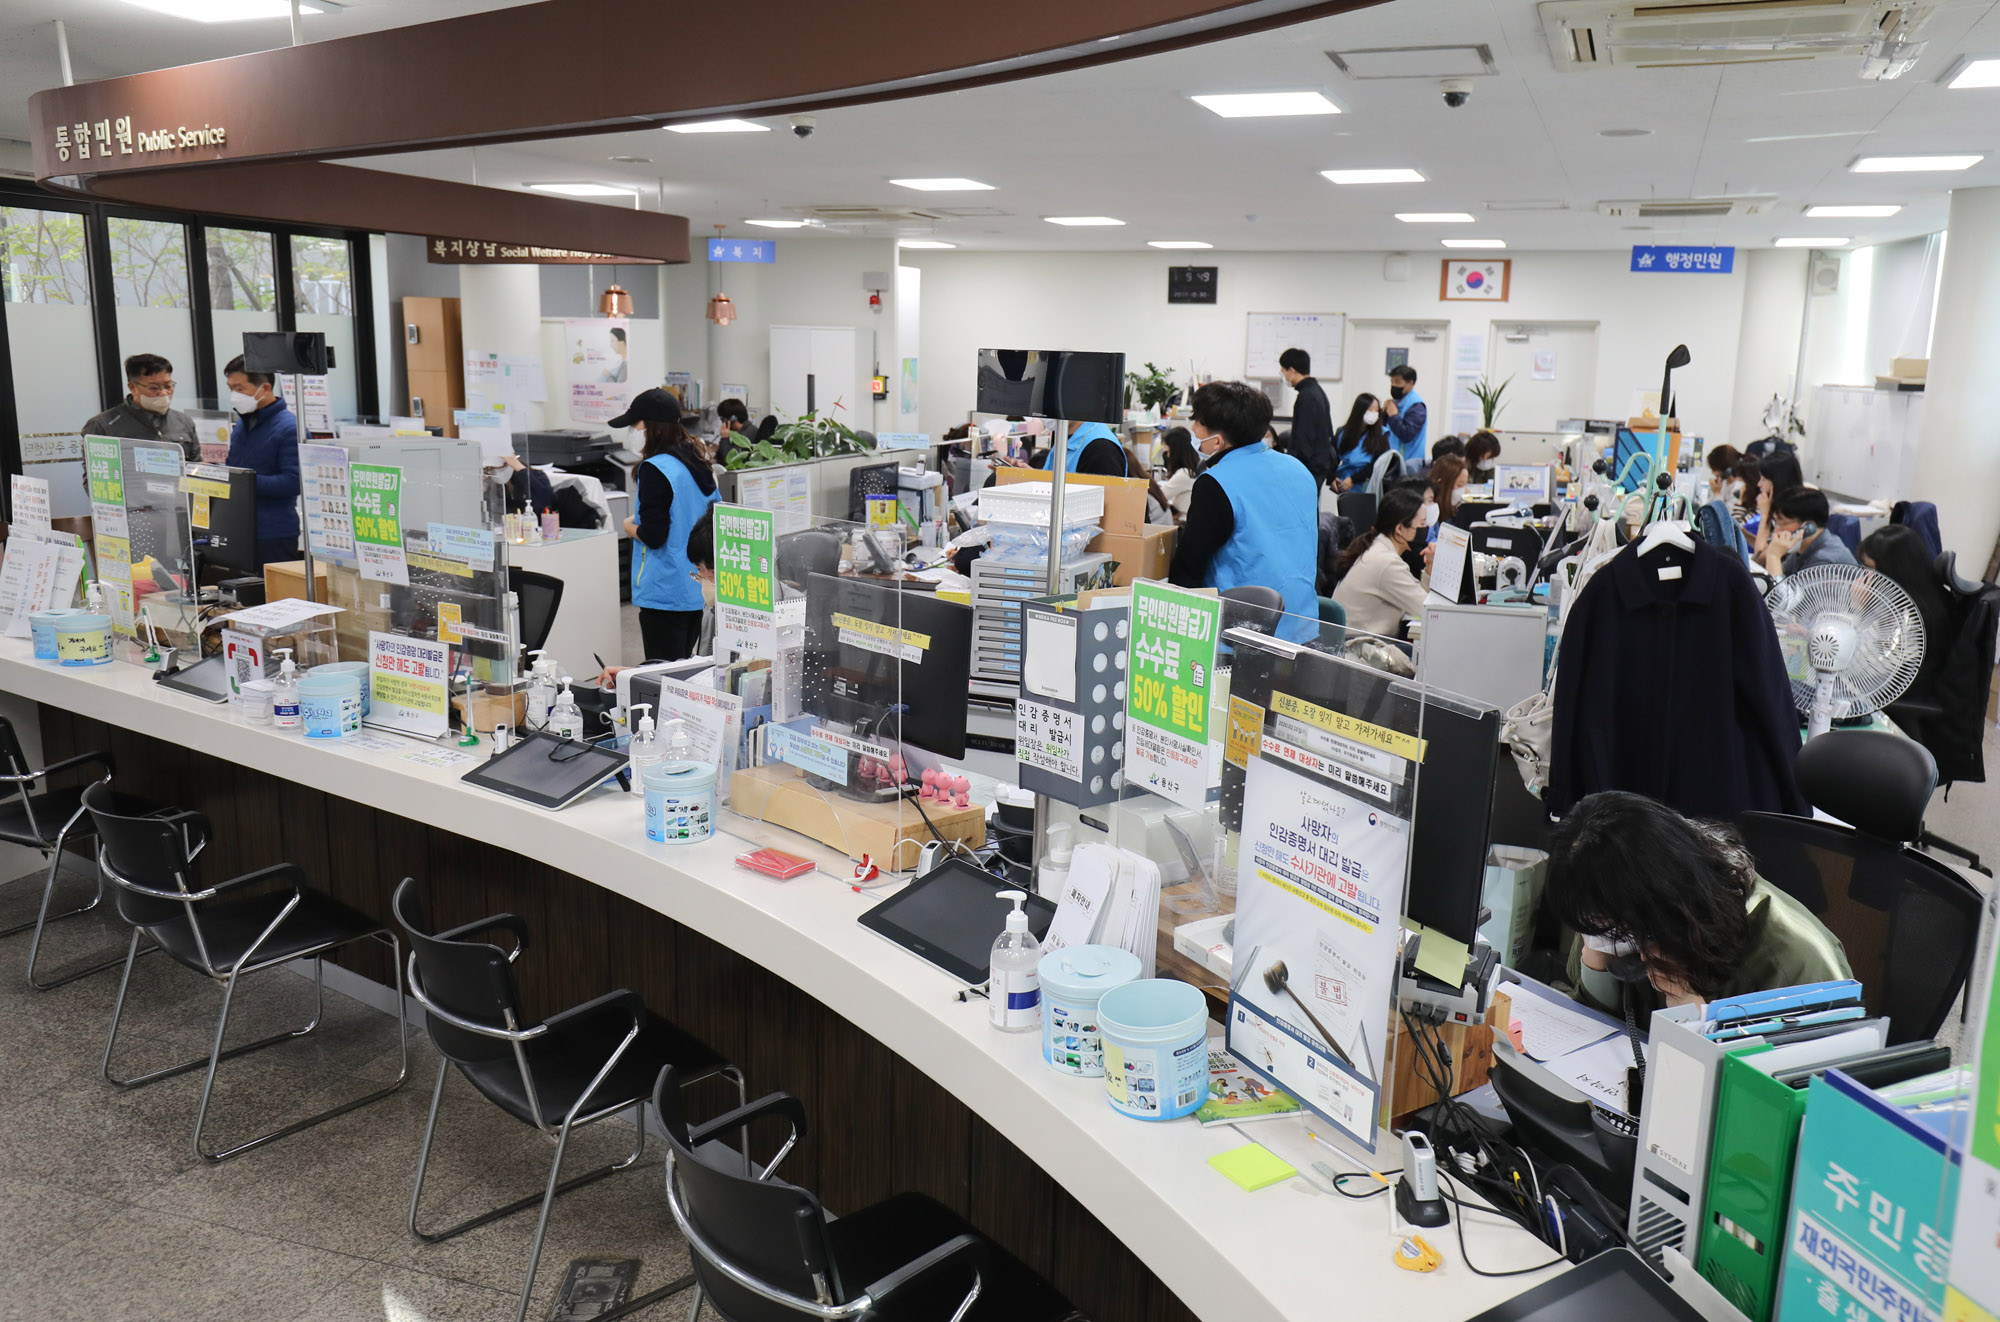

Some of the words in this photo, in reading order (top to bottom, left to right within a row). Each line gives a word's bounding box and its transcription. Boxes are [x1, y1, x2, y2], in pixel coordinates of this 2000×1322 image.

[55, 115, 133, 162] 통합민원
[137, 128, 176, 153] Public
[177, 123, 226, 148] Service
[500, 246, 529, 258] Social
[1665, 251, 1722, 270] 행정민원
[353, 490, 382, 516] 수수료
[355, 515, 378, 539] 50%
[378, 517, 399, 542] 할인
[719, 514, 769, 542] 무인민원발급기
[719, 540, 751, 571] 수수료
[720, 570, 745, 600] 50%
[746, 573, 770, 606] 할인
[1137, 594, 1213, 642] 무인민원발급기
[375, 653, 396, 671] 신청만
[396, 657, 410, 673] 해도
[396, 643, 417, 658] 인감증명
[417, 647, 443, 663] 대리발급은
[1134, 631, 1181, 681] 수수료
[1018, 703, 1072, 730] 인감증명서
[1133, 673, 1168, 719] 50%
[1171, 683, 1204, 734] 할인
[1278, 696, 1300, 714] 신분증,
[1302, 704, 1316, 720] 도장
[1319, 710, 1333, 727] 잊지
[1336, 716, 1350, 732] 말고
[851, 739, 861, 750] 미리
[1018, 719, 1039, 736] 대리
[1048, 727, 1072, 747] 발급시
[1135, 725, 1159, 743] 인감증명서,
[1017, 735, 1043, 751] 위임장은
[1045, 742, 1071, 760] 위임자가
[1135, 747, 1146, 758] 발급
[1145, 749, 1168, 767] 가능합니다.
[1017, 748, 1031, 761] 직접
[1032, 751, 1058, 768] 작성해야
[1059, 760, 1080, 778] 합니다.
[1262, 738, 1281, 753] 수수료
[1283, 745, 1296, 758] 면제
[1298, 752, 1325, 772] 대상자는
[1328, 761, 1343, 777] 미리
[1344, 770, 1390, 797] 말씀해주세요.
[1161, 778, 1180, 793] 용산구
[1301, 815, 1339, 846] 사망자의
[1269, 821, 1317, 857] 인감증명서
[1318, 845, 1339, 868] 대리
[1341, 854, 1370, 883] 발급은
[1254, 838, 1275, 860] 신청만
[1274, 849, 1290, 866] 해도
[1289, 854, 1337, 890] 수사기관에
[1336, 876, 1382, 912] 고발됩니다.
[1319, 980, 1342, 1000] 불법
[1238, 1011, 1246, 1022] 1
[1307, 1056, 1315, 1068] 2
[1659, 1149, 1688, 1170] SYSMAX
